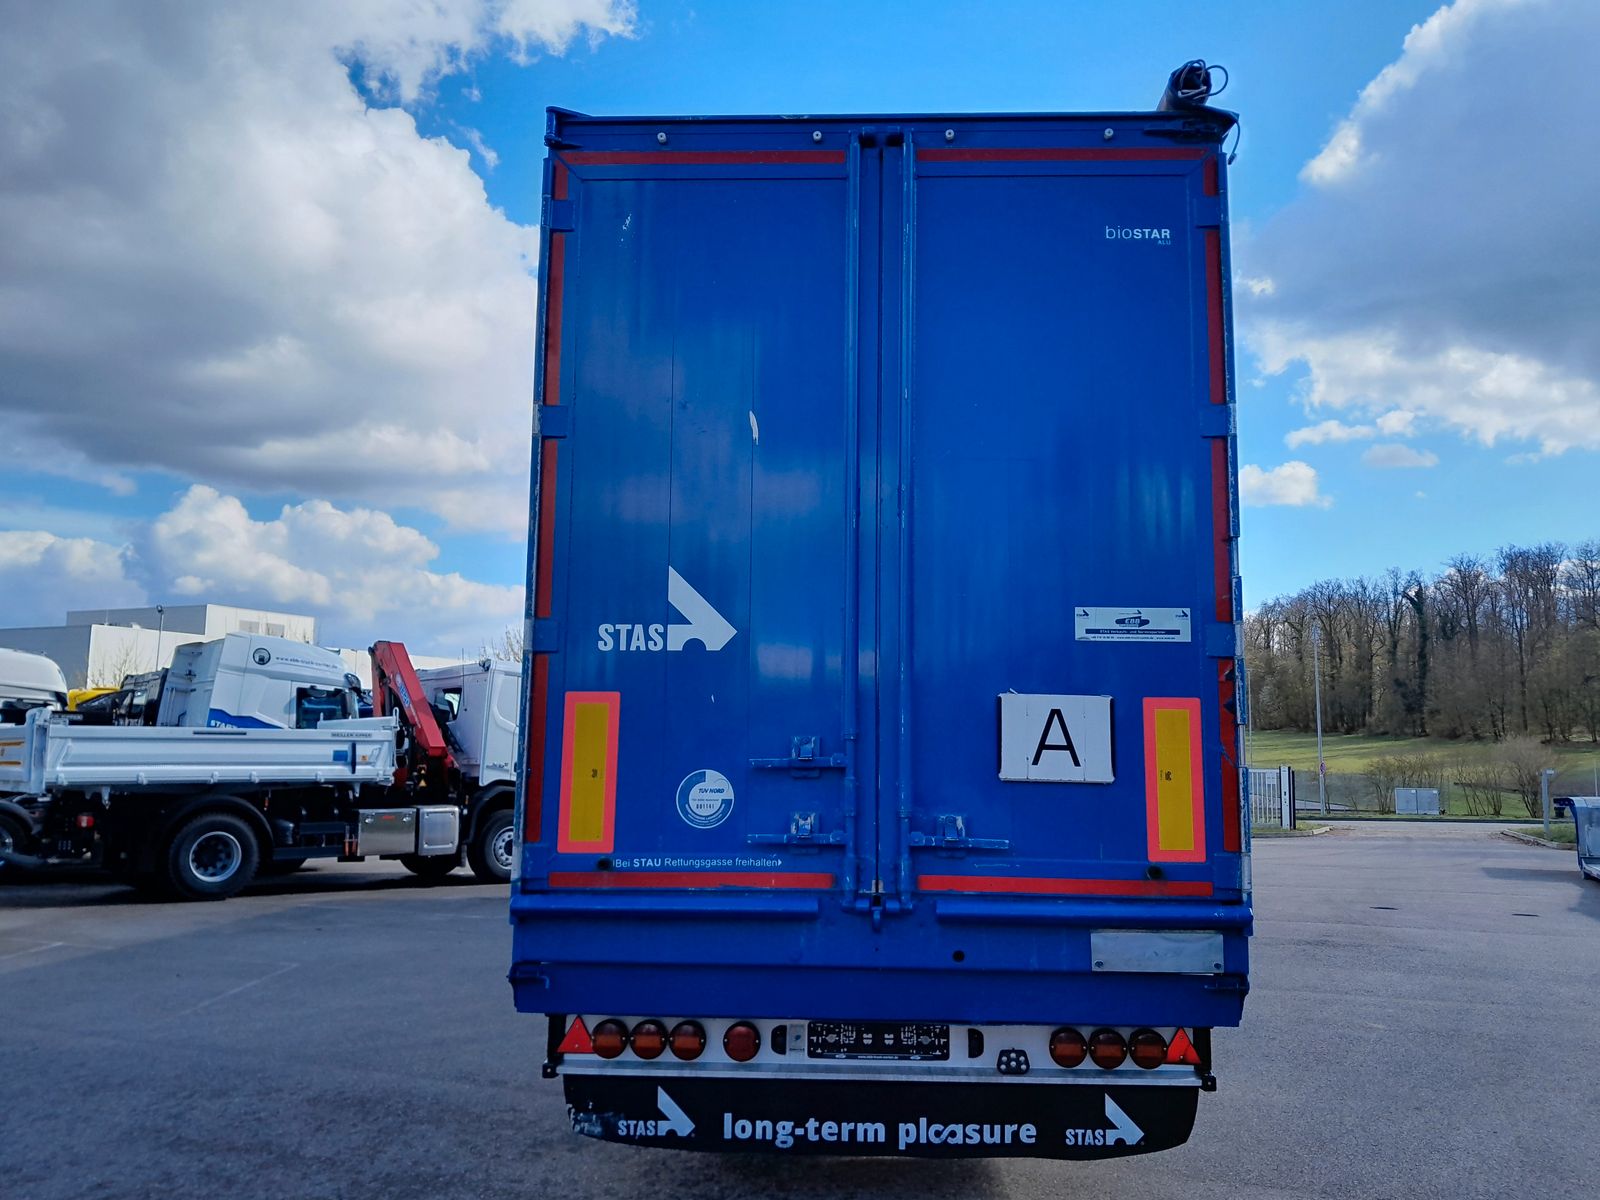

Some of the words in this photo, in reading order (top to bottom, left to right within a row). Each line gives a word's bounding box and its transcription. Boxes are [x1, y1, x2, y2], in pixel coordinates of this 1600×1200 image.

[1105, 225, 1170, 239] bioSTAR
[597, 623, 665, 651] STAS
[1031, 708, 1082, 767] A
[615, 858, 631, 868] Bei
[633, 858, 661, 867] STAU
[664, 857, 733, 869] Rettungsgasse
[735, 857, 778, 867] freihalten
[617, 1120, 656, 1137] STAS
[723, 1112, 886, 1149] long-term
[898, 1116, 1037, 1150] pleasure
[1065, 1128, 1104, 1146] STAS
